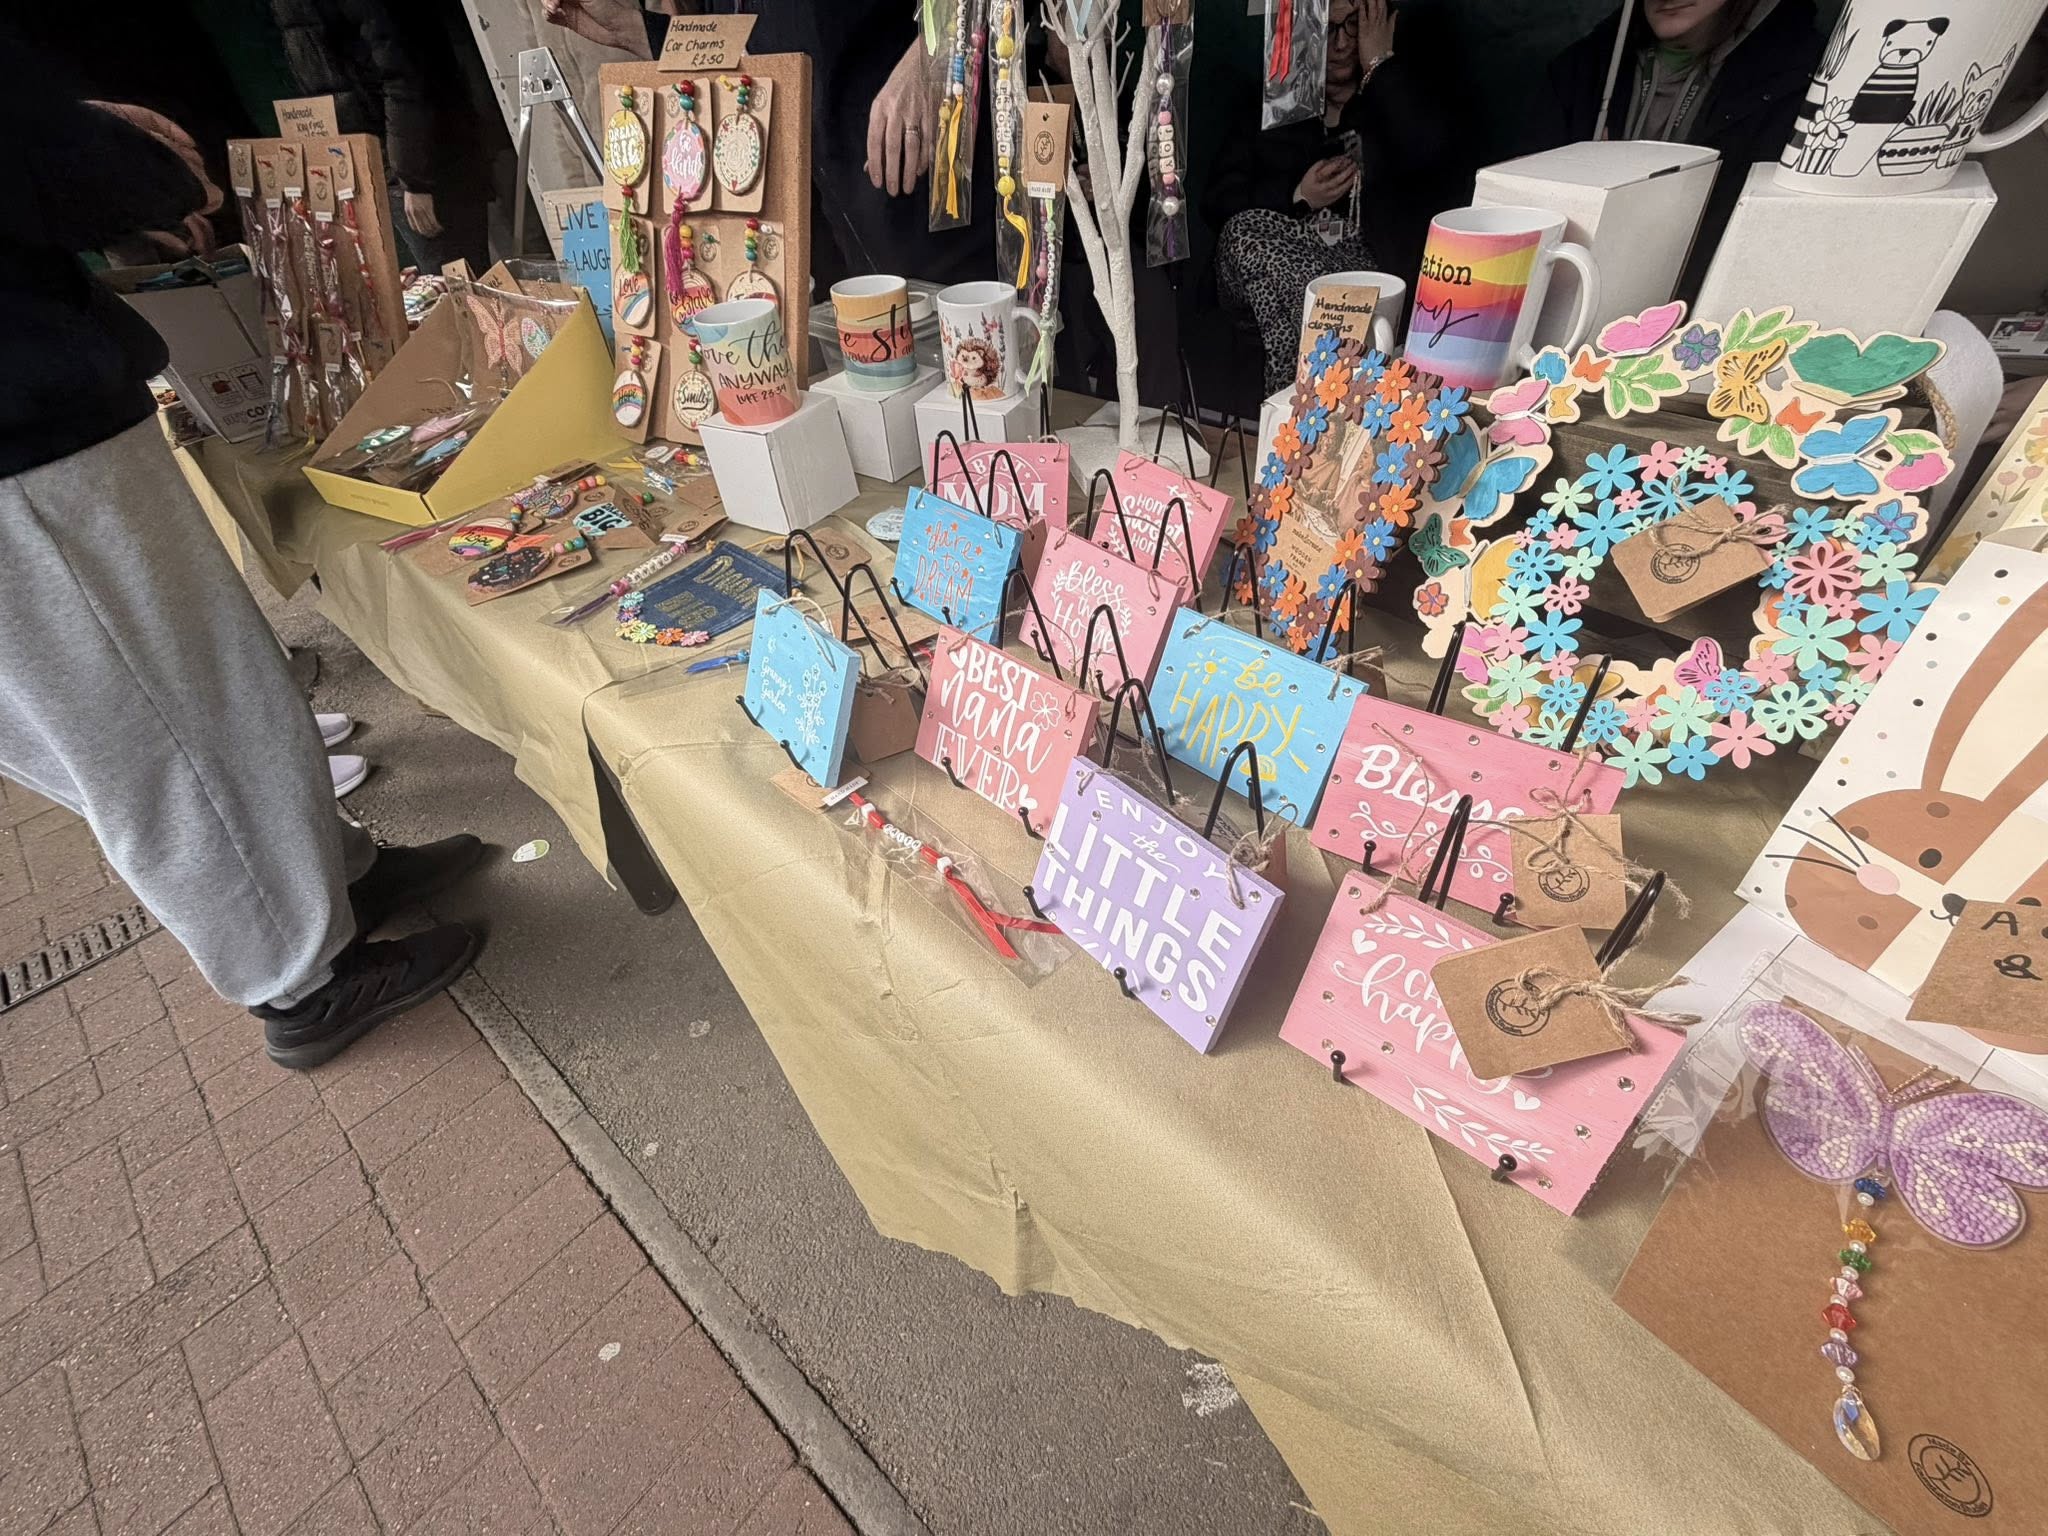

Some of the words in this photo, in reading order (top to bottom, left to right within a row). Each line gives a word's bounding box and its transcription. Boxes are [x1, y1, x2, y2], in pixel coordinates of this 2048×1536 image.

[665, 39, 682, 52] Car
[685, 39, 725, 52] Charms
[670, 20, 718, 32] Handmade
[555, 202, 599, 231] LIVE
[1421, 254, 1473, 286] ation
[1315, 297, 1373, 315] Handmade
[1320, 311, 1345, 325] mug
[703, 347, 740, 366] ove
[728, 320, 785, 369] th
[718, 358, 792, 390] ANYWAY
[940, 482, 1048, 516] MOM
[1136, 493, 1168, 516] HOM
[581, 508, 622, 531] BIG
[927, 521, 976, 561] dare
[913, 555, 975, 616] DREAM
[1064, 560, 1126, 612] Bless
[1077, 595, 1095, 618] th
[966, 641, 1040, 711] BEST
[1233, 658, 1284, 698] be
[1168, 671, 1304, 769] HAPPY
[931, 722, 1021, 810] EVER
[1095, 788, 1227, 882] ENJOY
[1128, 830, 1182, 874] the
[1046, 803, 1243, 973] LITTLE
[1042, 854, 1217, 1013] THINGS
[1332, 953, 1553, 1095] hap
